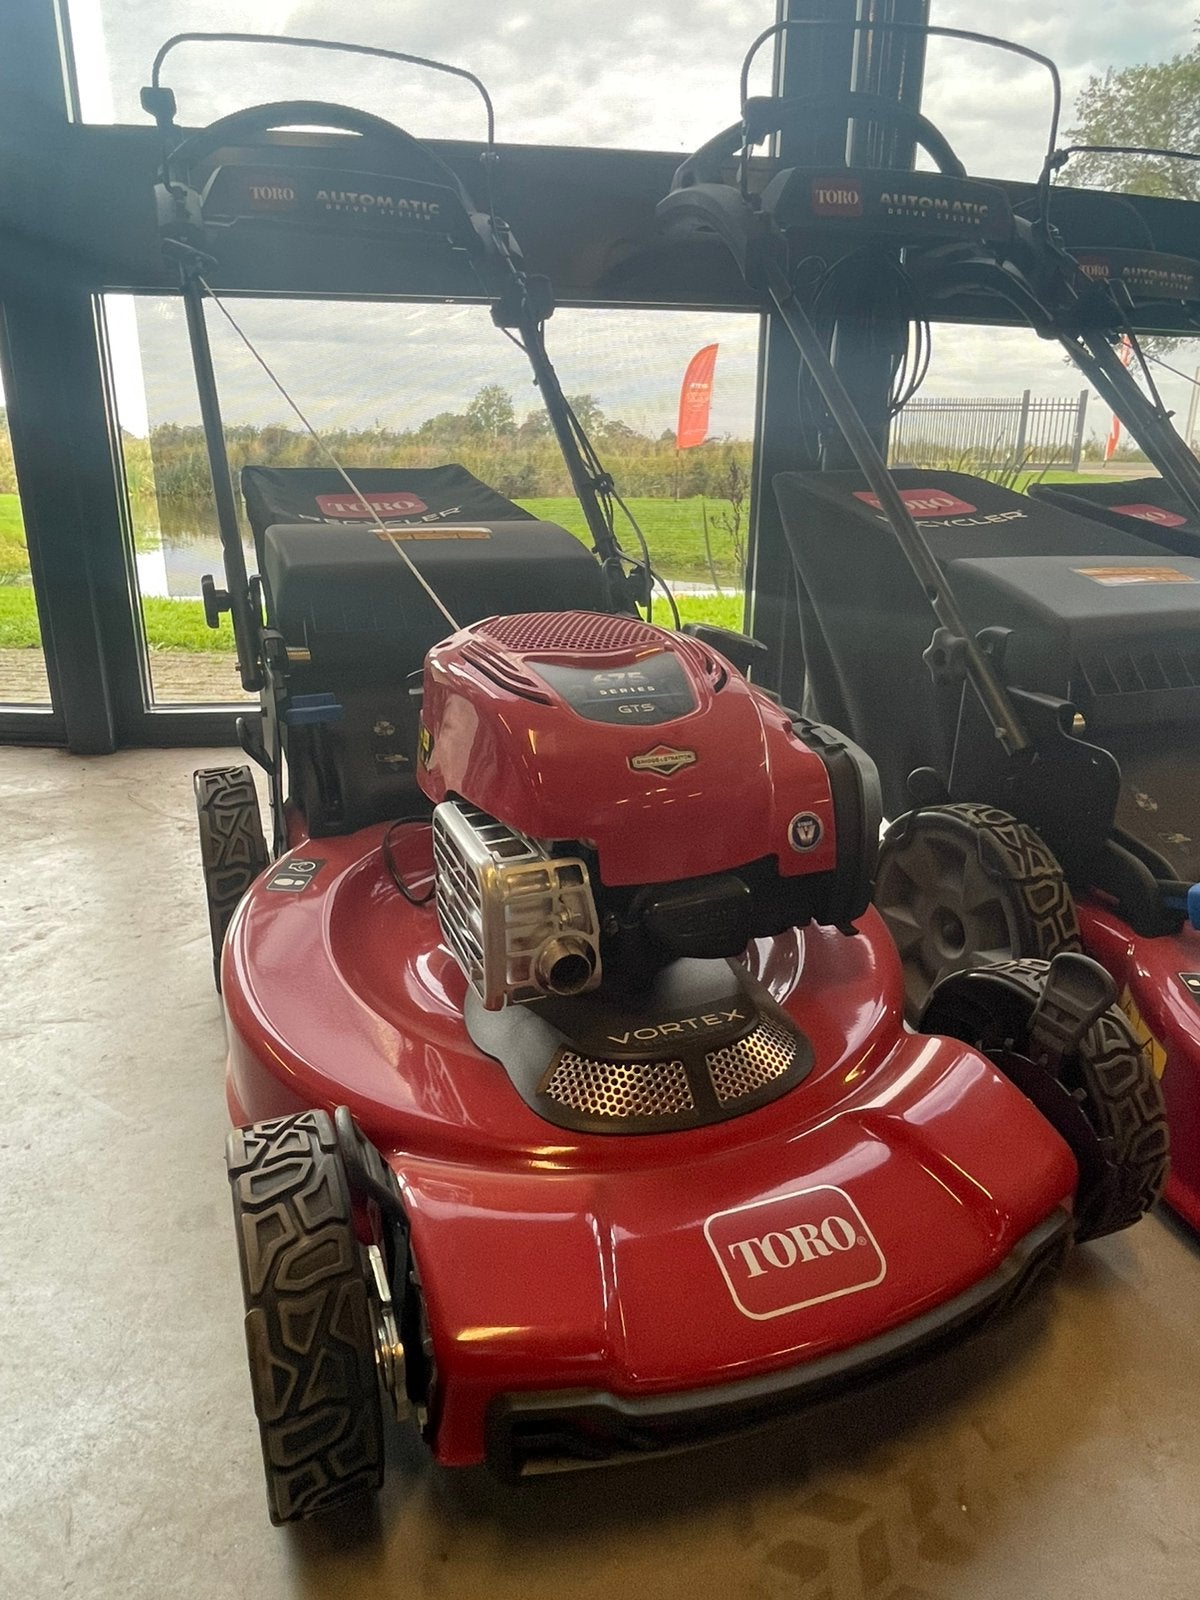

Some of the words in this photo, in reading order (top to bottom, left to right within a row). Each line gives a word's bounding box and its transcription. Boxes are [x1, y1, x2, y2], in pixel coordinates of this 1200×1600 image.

[250, 186, 295, 200] TORO
[815, 189, 859, 205] TORO
[316, 189, 440, 215] AUTOMATIC
[880, 192, 989, 217] AUTOMATIC
[1122, 266, 1195, 283] AUTOMATIC
[327, 500, 416, 513] TORO
[599, 685, 656, 696] SERIES
[617, 702, 656, 714] GTS
[607, 1008, 746, 1045] VORTEX
[727, 1215, 857, 1279] TORO
